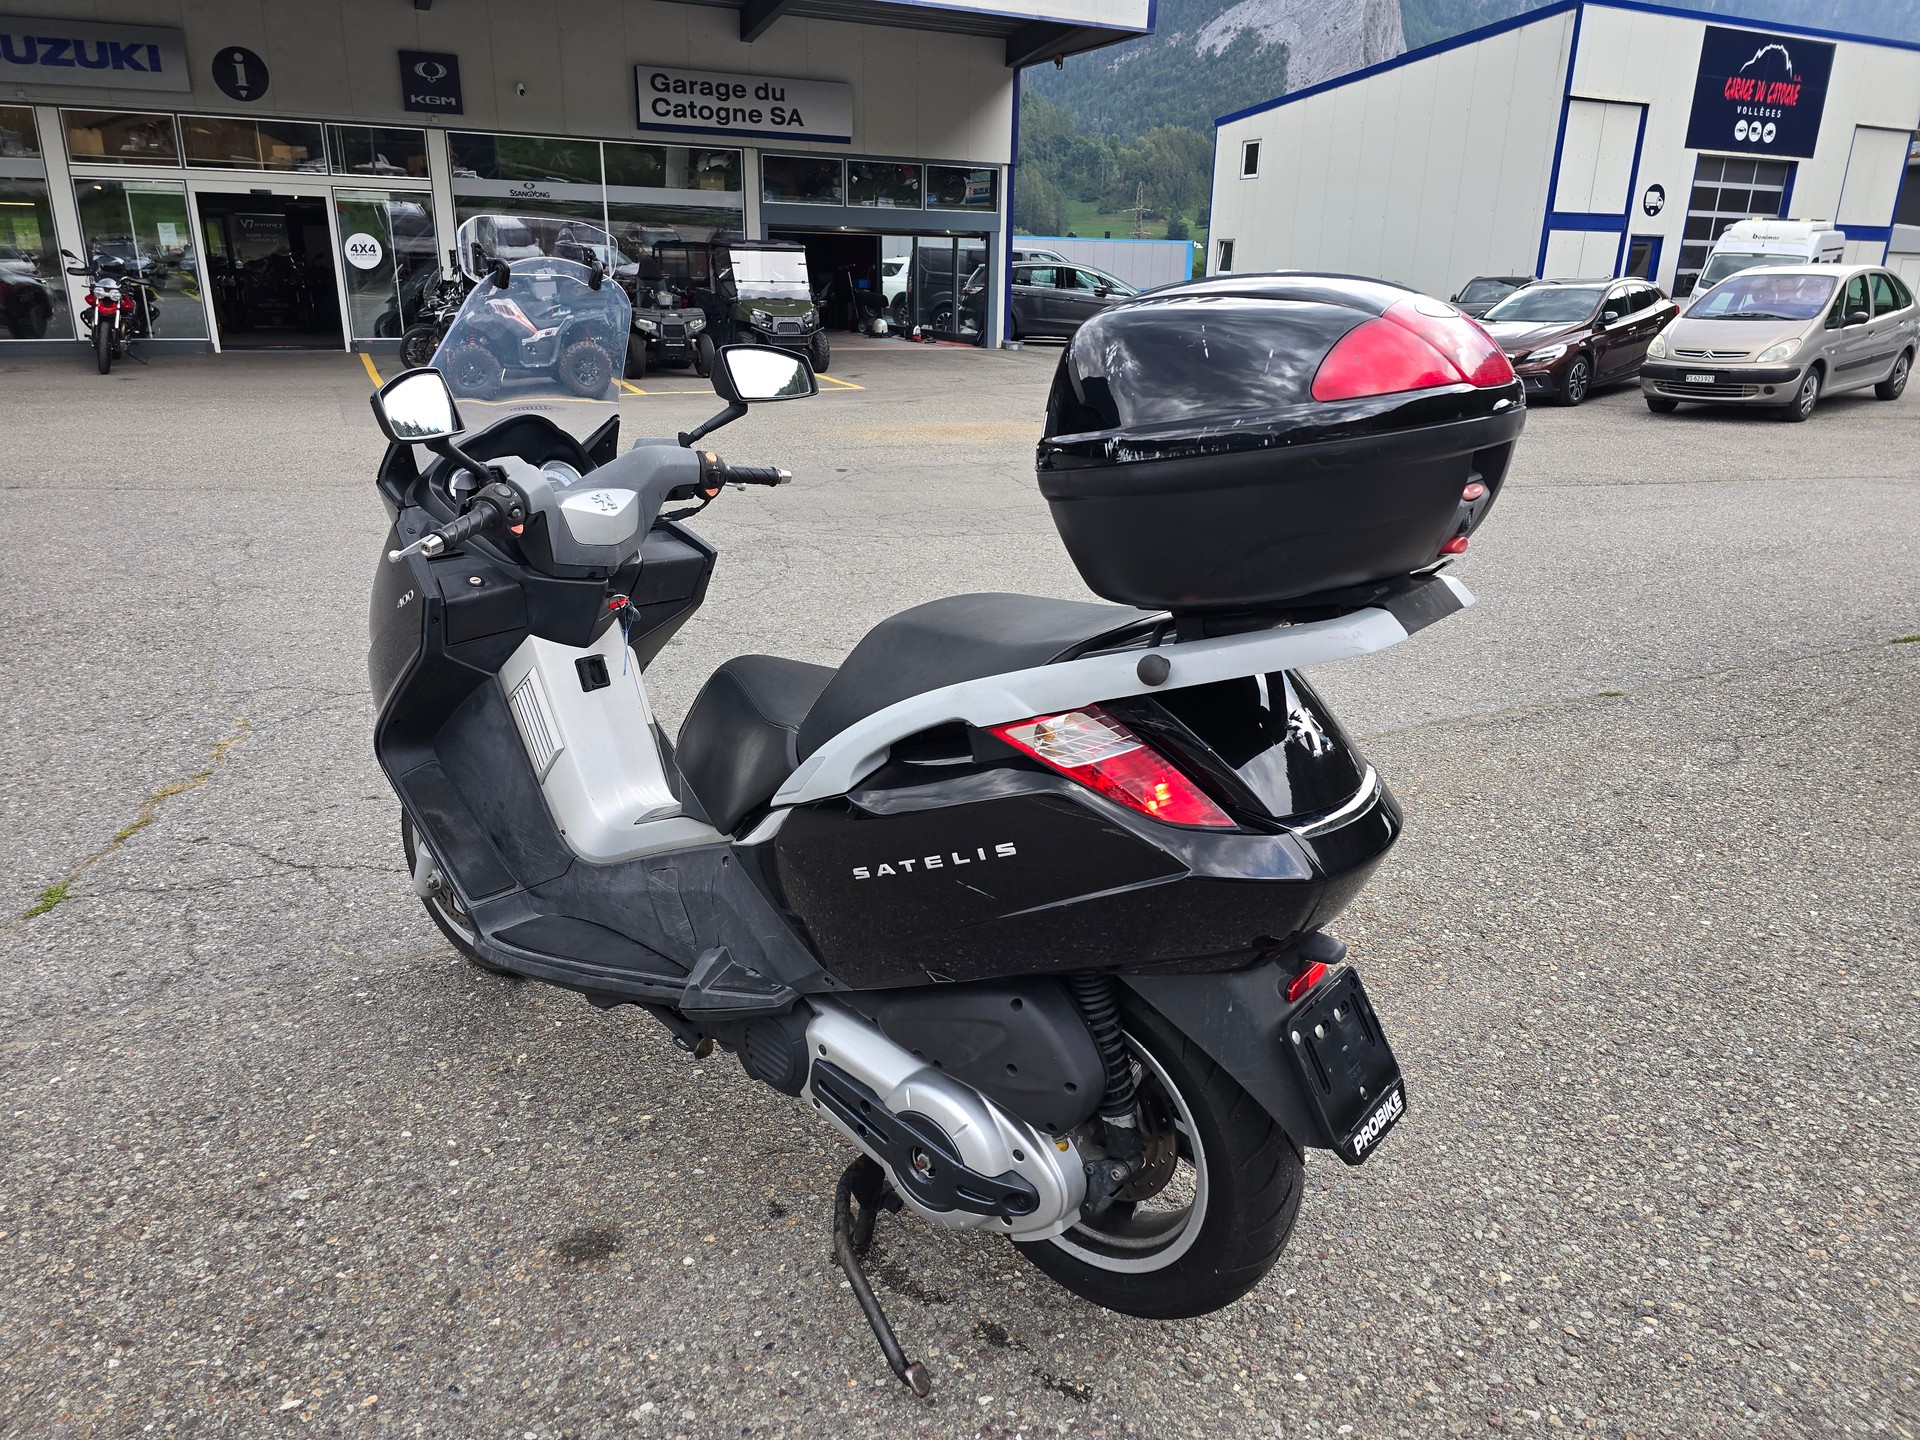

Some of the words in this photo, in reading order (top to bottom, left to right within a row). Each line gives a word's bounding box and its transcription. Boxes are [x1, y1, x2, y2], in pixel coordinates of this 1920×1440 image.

[0, 34, 163, 73] UZUKI
[411, 94, 457, 106] KGM
[650, 72, 747, 102] Garage
[754, 82, 786, 102] du
[1724, 76, 1756, 102] GARAGE
[1755, 79, 1768, 103] DU
[1767, 81, 1801, 106] CATOGNE
[651, 97, 763, 126] Catogne
[770, 106, 804, 127] SA
[1737, 105, 1782, 118] VOLLÈGES
[240, 219, 254, 229] V7
[350, 243, 377, 253] 4X4
[397, 589, 414, 609] 400
[852, 841, 1018, 880] SATELIS
[1353, 1089, 1403, 1156] PROBIKE
